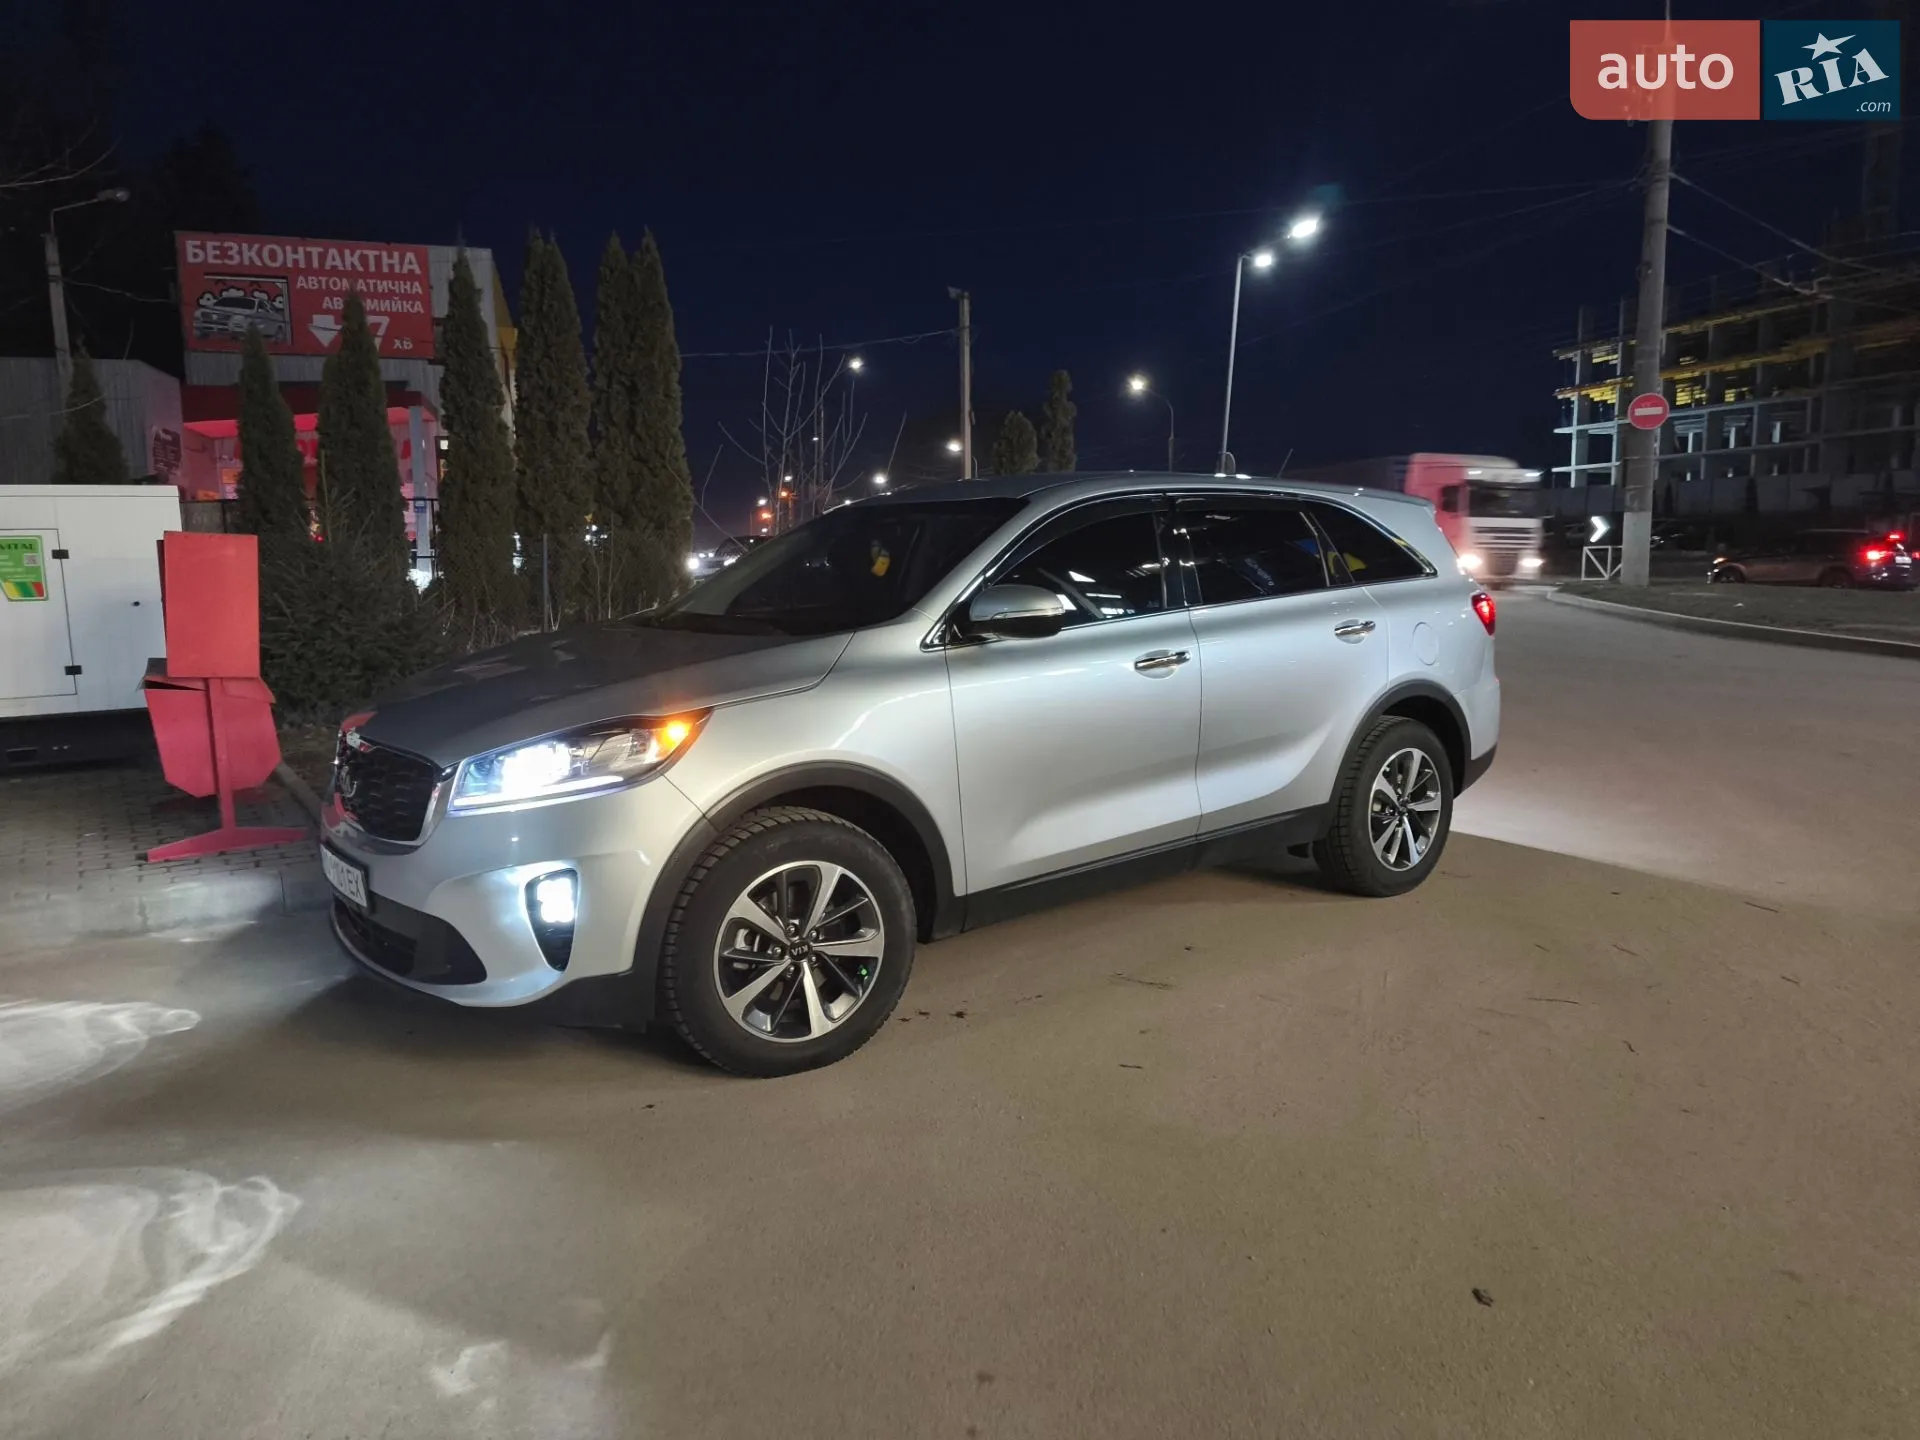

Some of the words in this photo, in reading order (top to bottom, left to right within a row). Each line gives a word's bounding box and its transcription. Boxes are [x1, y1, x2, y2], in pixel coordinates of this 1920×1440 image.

[185, 240, 421, 274] БЕЗКОНТАКТНА
[322, 296, 425, 314] АВМИЙКА
[791, 945, 808, 956] KIA
